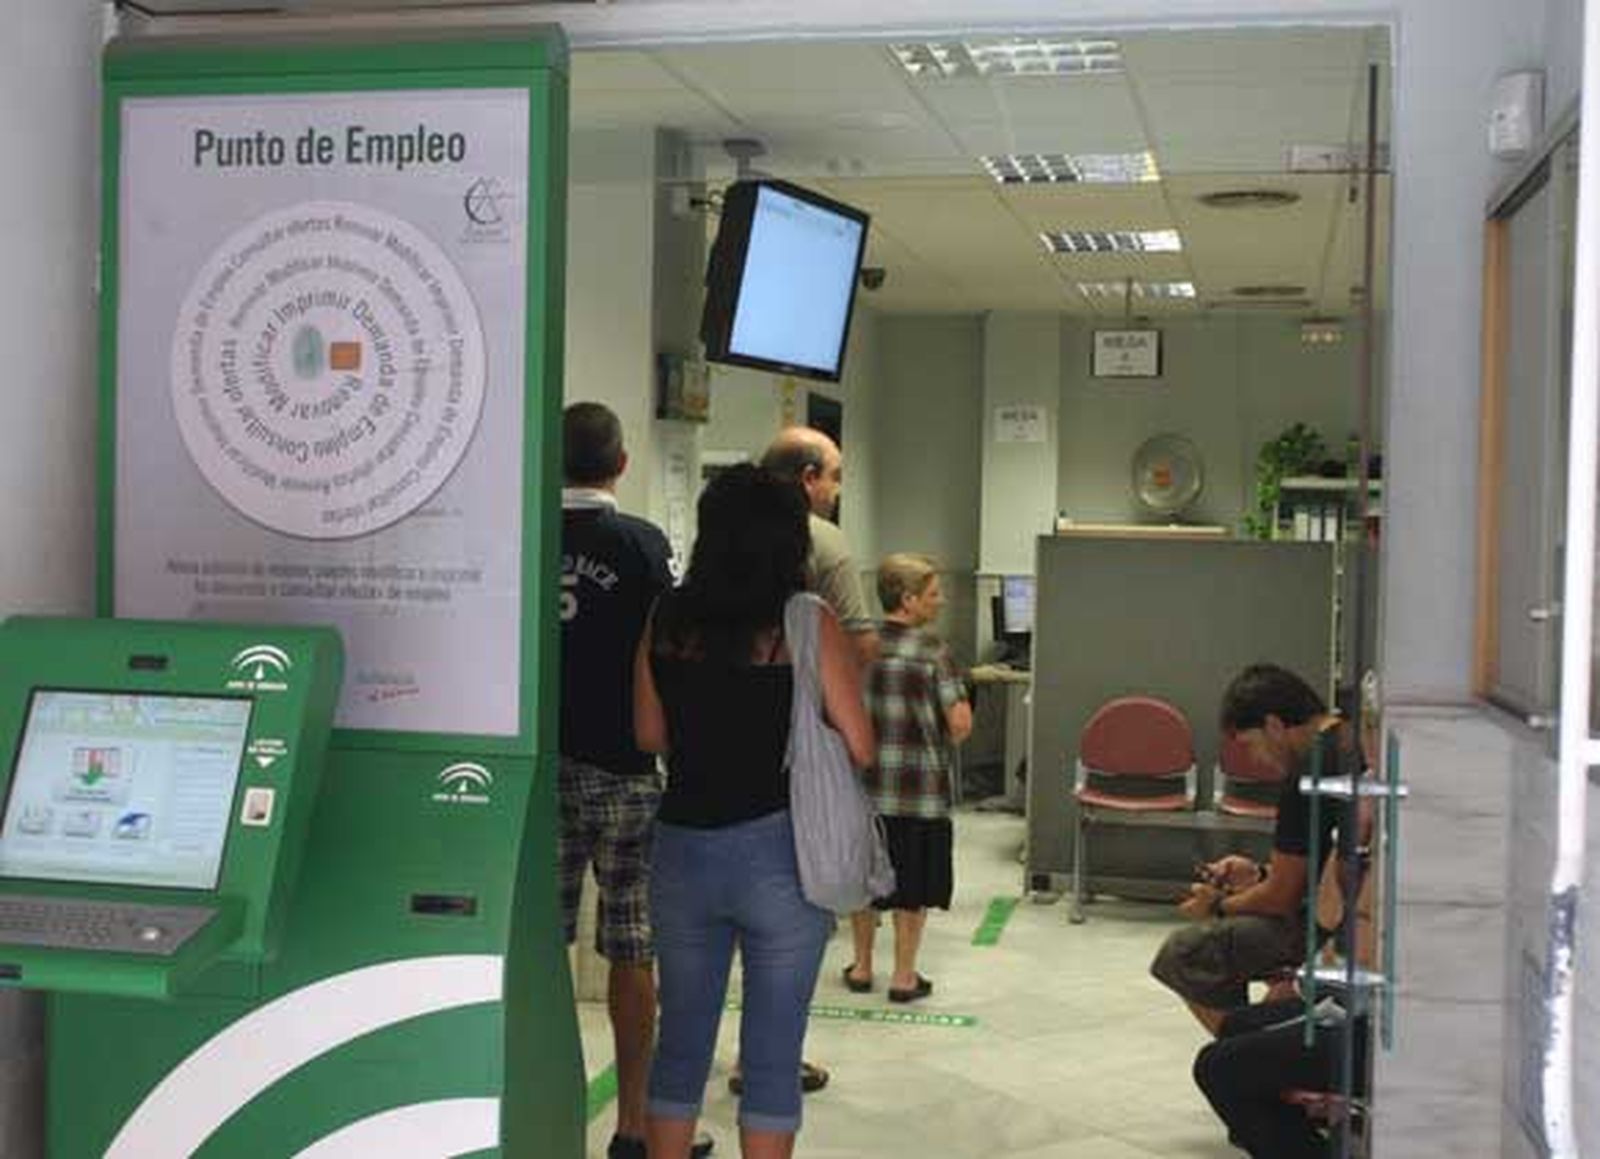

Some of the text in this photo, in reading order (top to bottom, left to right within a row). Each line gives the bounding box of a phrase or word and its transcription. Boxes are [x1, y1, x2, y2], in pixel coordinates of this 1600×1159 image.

[194, 125, 466, 171] Punto de Empleo
[272, 290, 352, 324] Imprimir
[220, 339, 244, 402] ofertas
[353, 299, 398, 388] Demanda
[236, 405, 308, 463] Consultar
